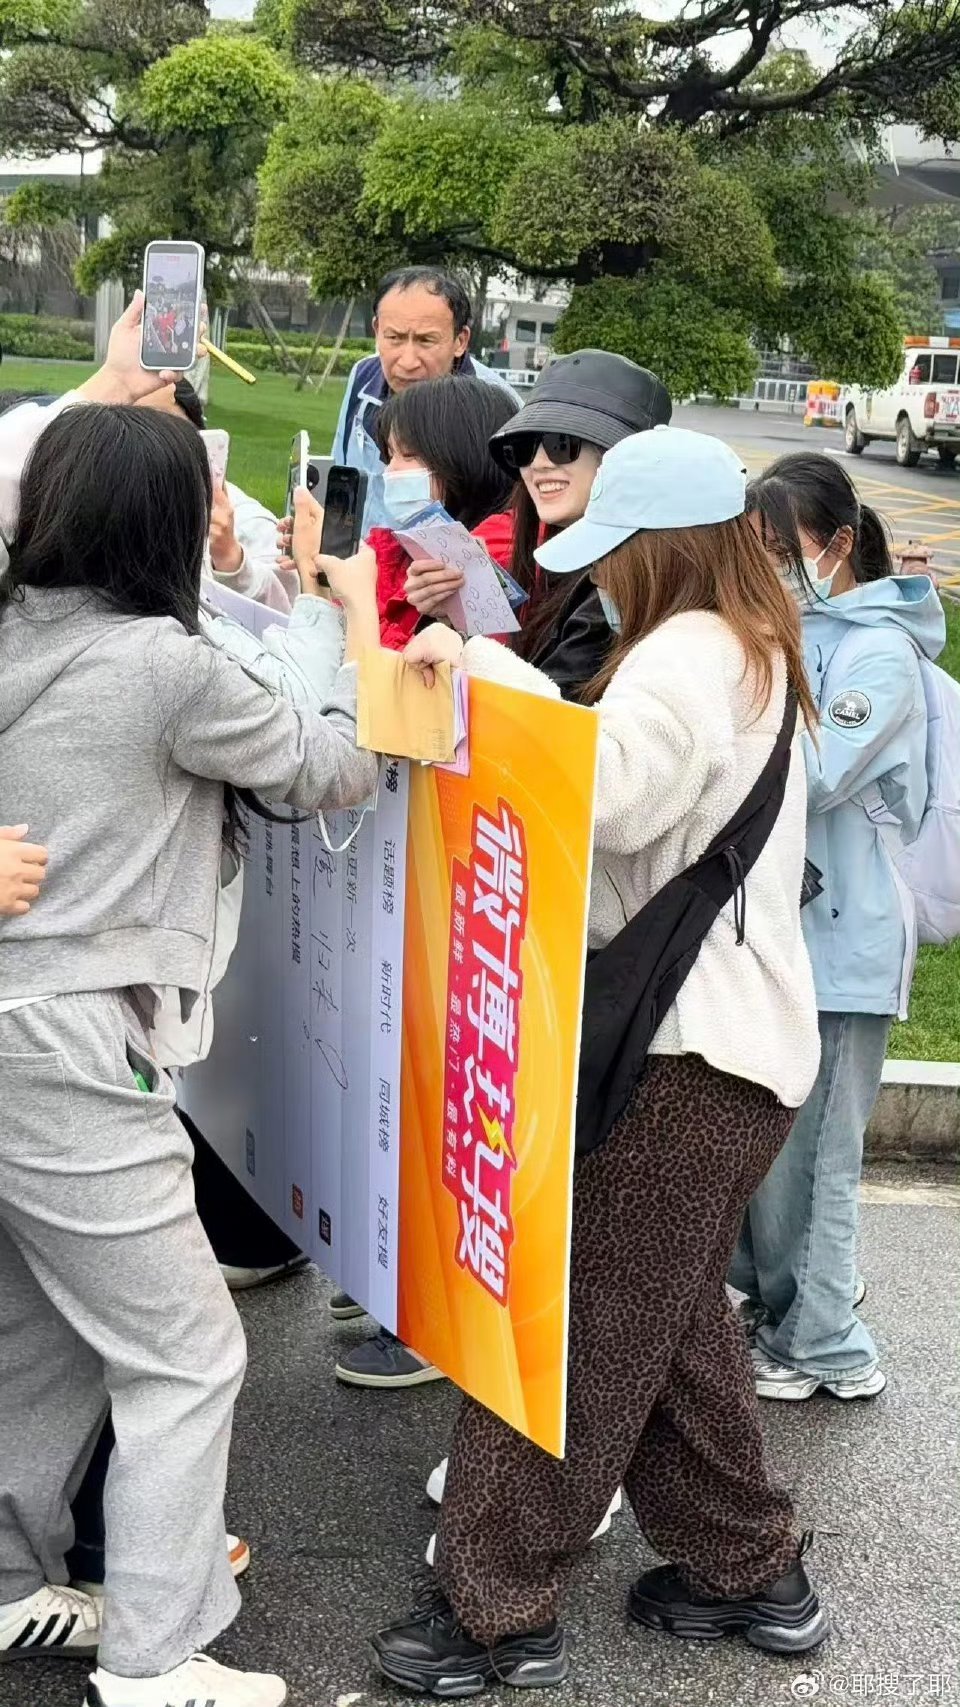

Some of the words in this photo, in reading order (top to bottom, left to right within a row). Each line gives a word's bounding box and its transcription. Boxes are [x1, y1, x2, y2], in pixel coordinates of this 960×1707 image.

[834, 708, 861, 720] CAMEL
[382, 840, 397, 915] 话题榜
[380, 960, 393, 1034] 新时代
[458, 806, 523, 1298] 微博热搜
[378, 1077, 391, 1153] 同城榜
[377, 1194, 390, 1270] 好友搜
